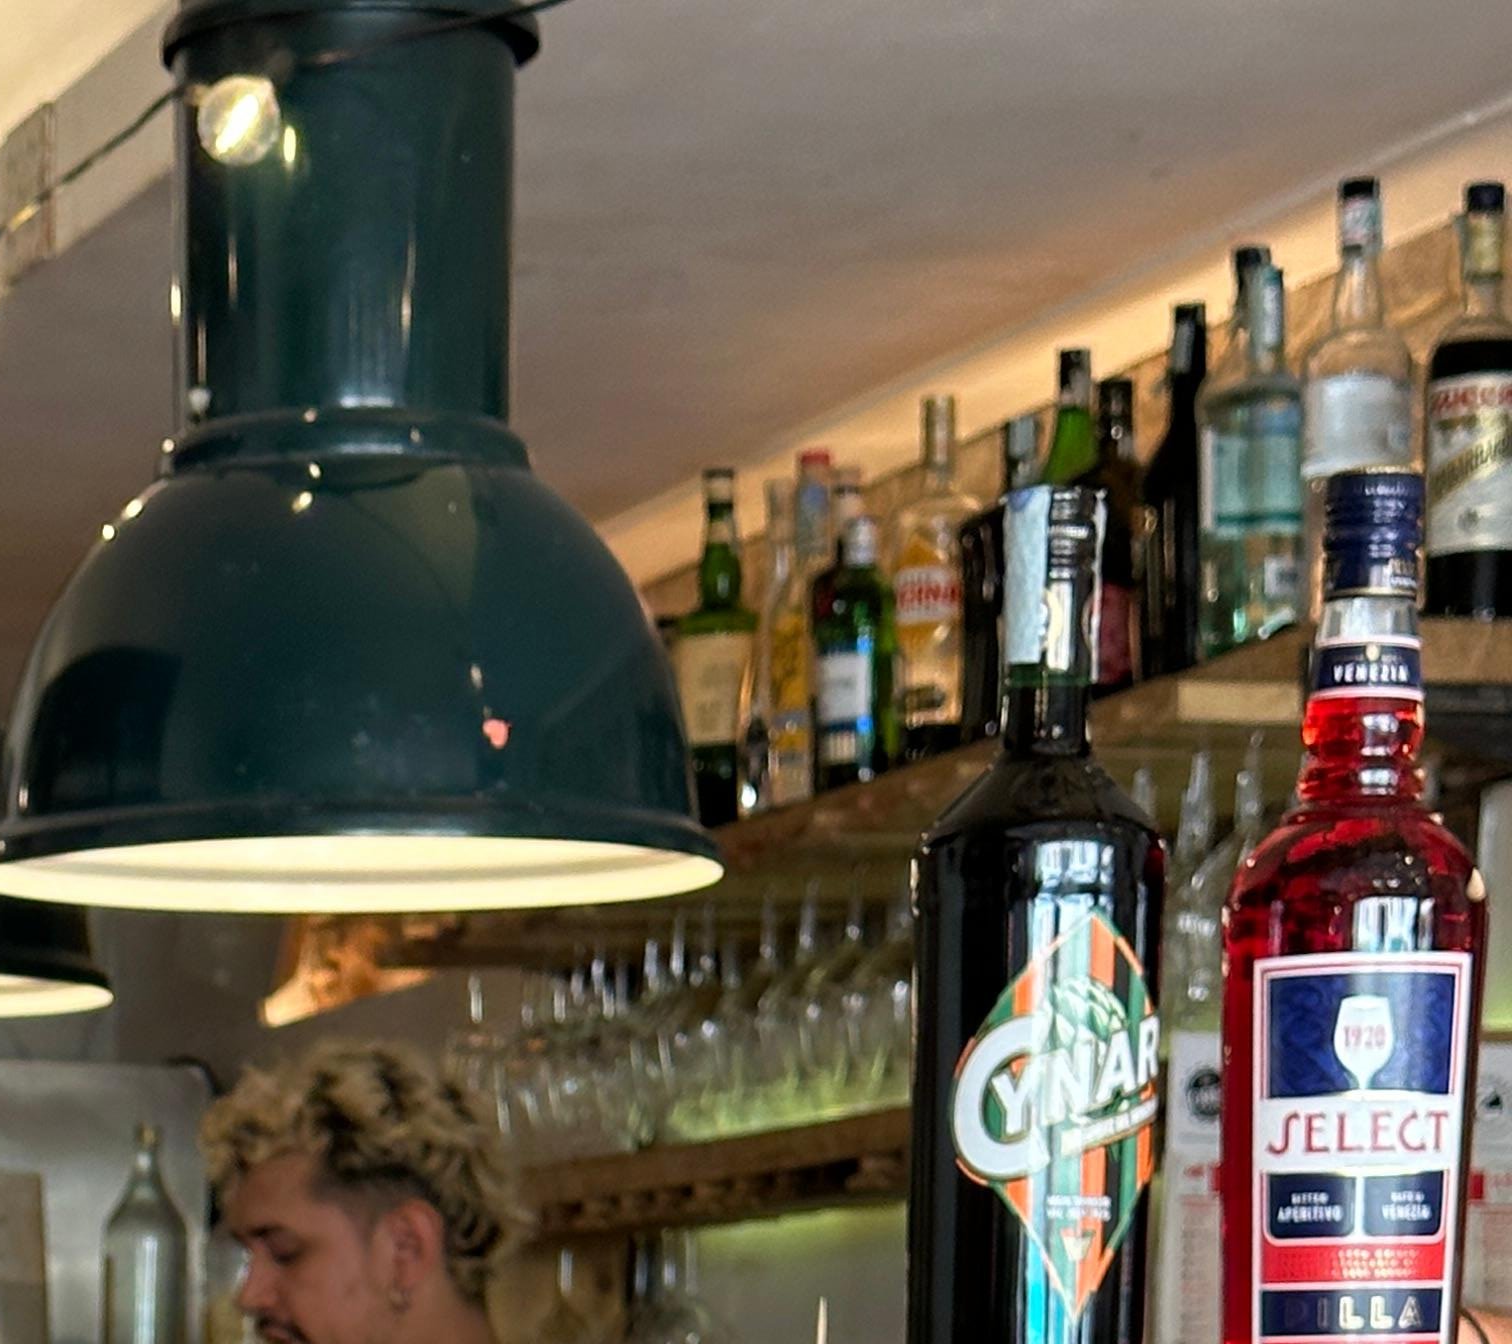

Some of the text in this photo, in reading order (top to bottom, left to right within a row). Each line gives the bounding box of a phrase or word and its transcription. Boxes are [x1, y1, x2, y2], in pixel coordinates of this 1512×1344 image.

[1333, 663, 1409, 683] VENEZIA
[1343, 1024, 1386, 1049] 1920
[953, 1013, 1160, 1177] CYNAR
[1267, 1110, 1449, 1155] SELECT
[1277, 1205, 1343, 1222] APERITIVO
[1382, 1204, 1432, 1221] VENEZIA
